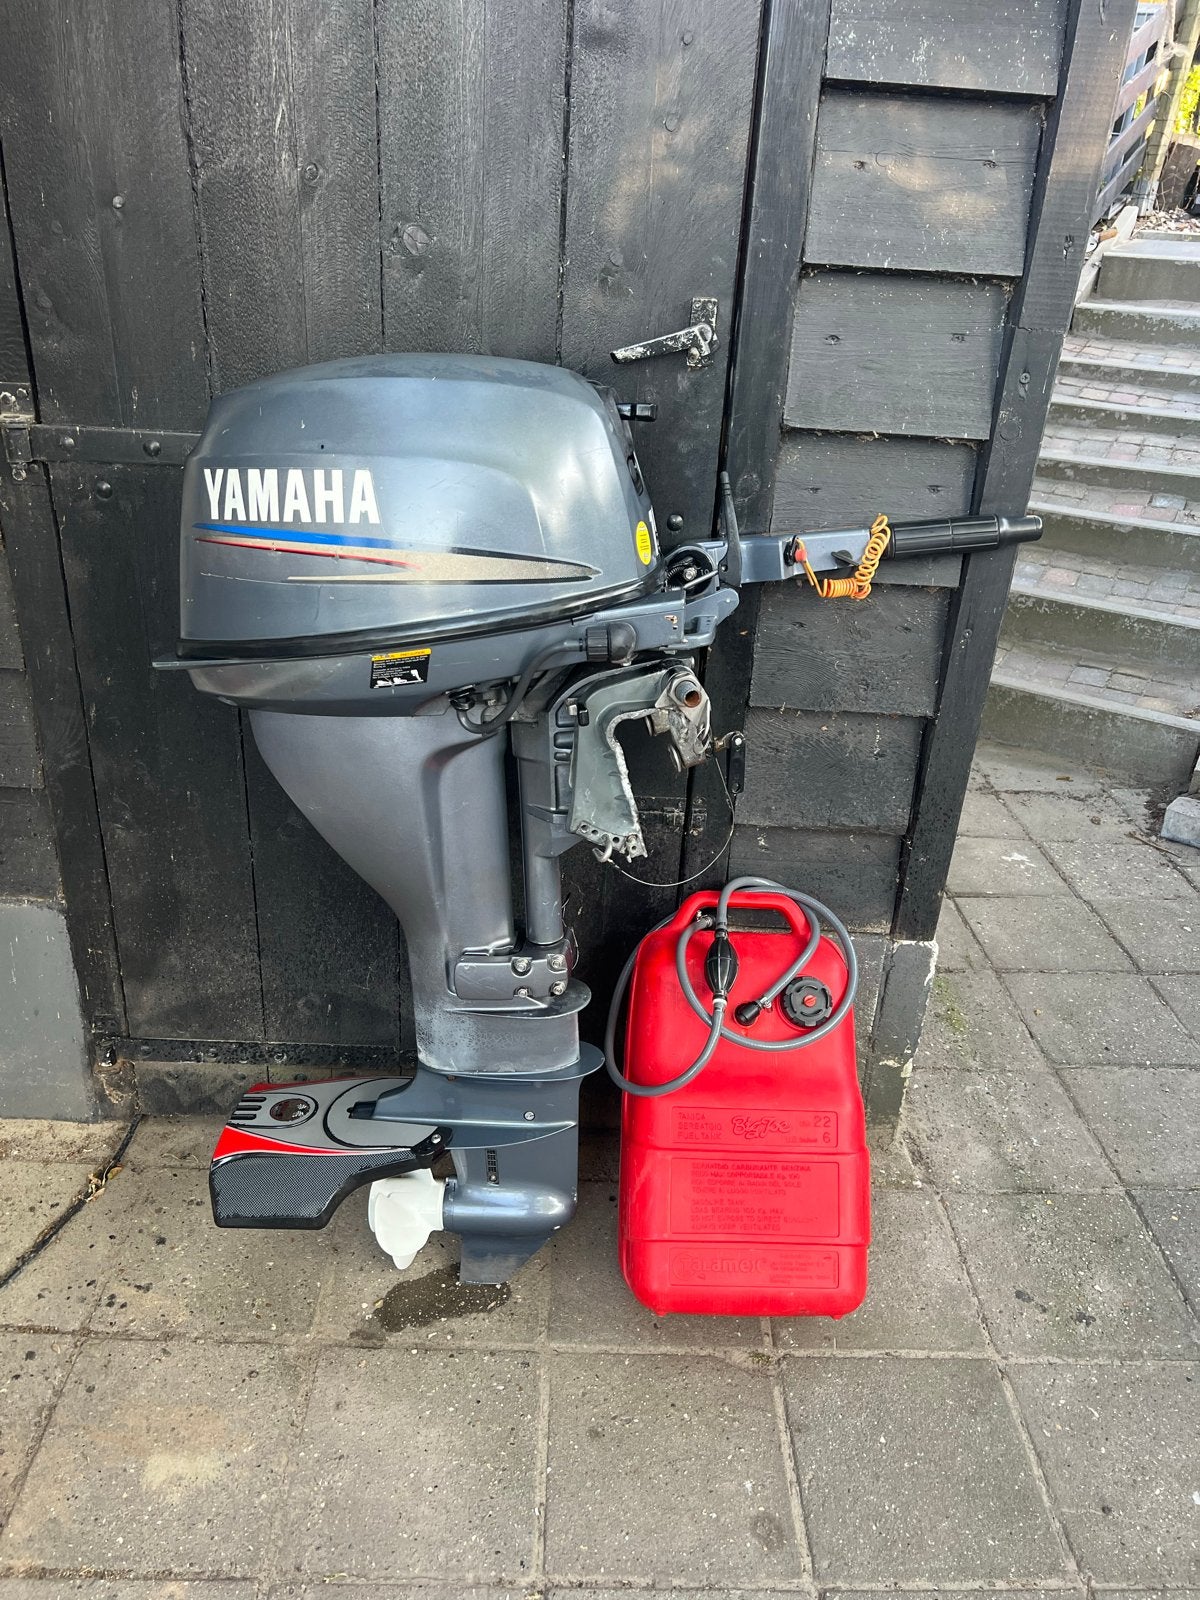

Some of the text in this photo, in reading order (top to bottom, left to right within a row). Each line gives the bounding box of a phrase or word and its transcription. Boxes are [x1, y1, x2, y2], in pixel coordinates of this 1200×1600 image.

[204, 468, 380, 524] YAMAHA
[814, 1115, 831, 1128] 22
[822, 1131, 831, 1144] 6
